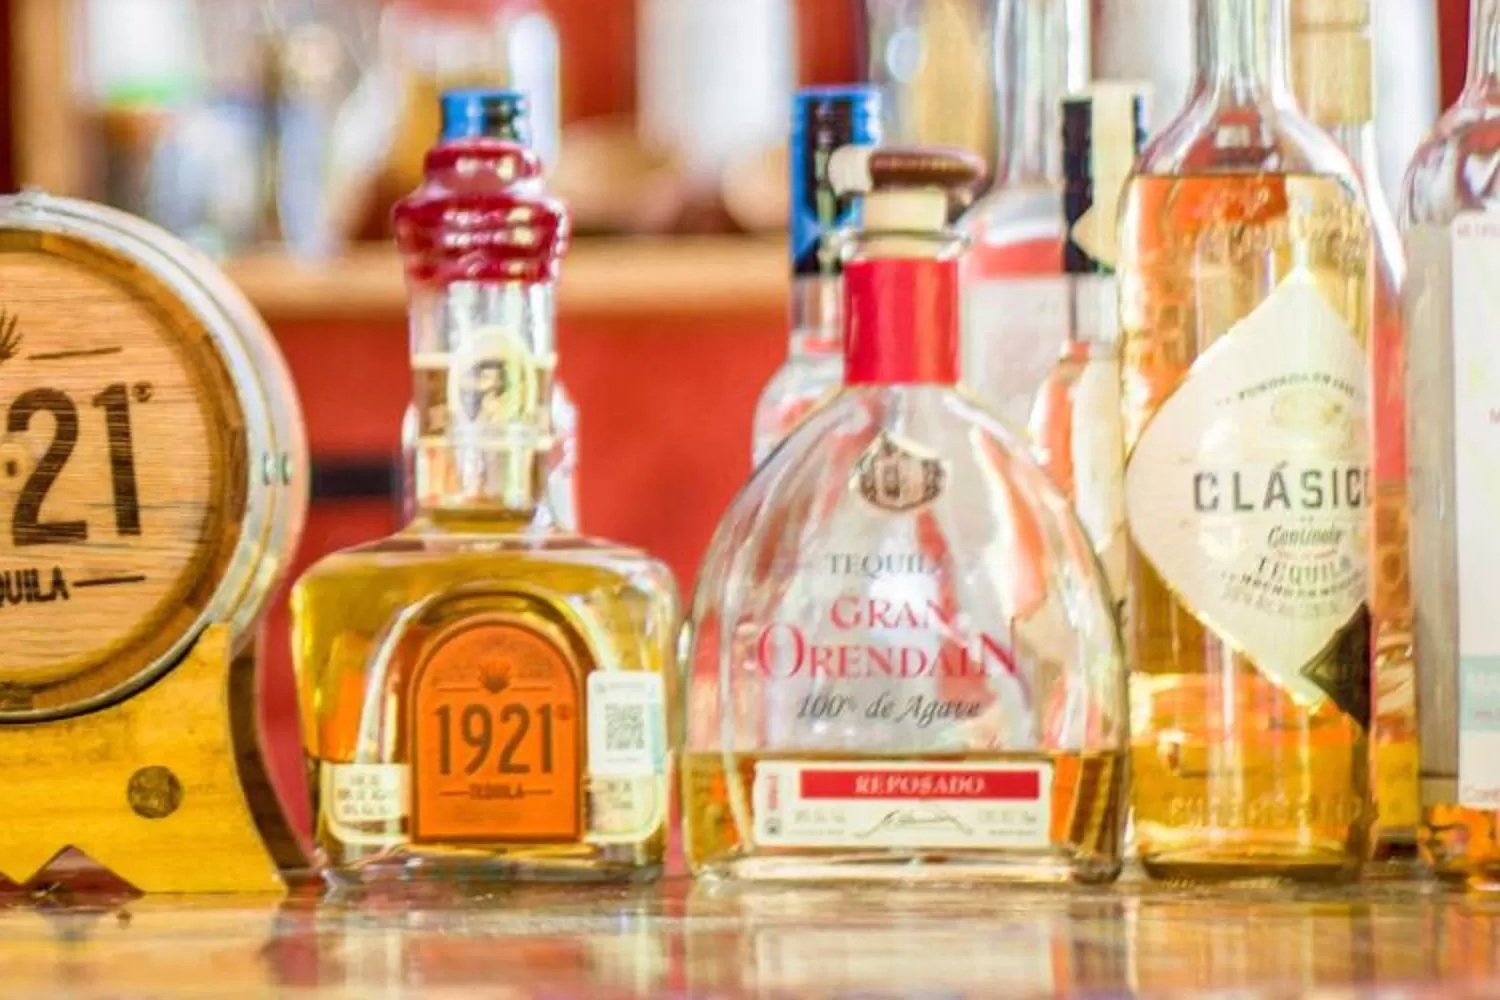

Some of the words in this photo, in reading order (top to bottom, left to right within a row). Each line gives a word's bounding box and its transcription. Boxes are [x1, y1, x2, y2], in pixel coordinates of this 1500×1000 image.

[829, 594, 960, 631] GRAN
[865, 689, 892, 720] de
[895, 694, 982, 728] Agave
[435, 703, 553, 776] 1921
[854, 775, 987, 795] REPOSADO
